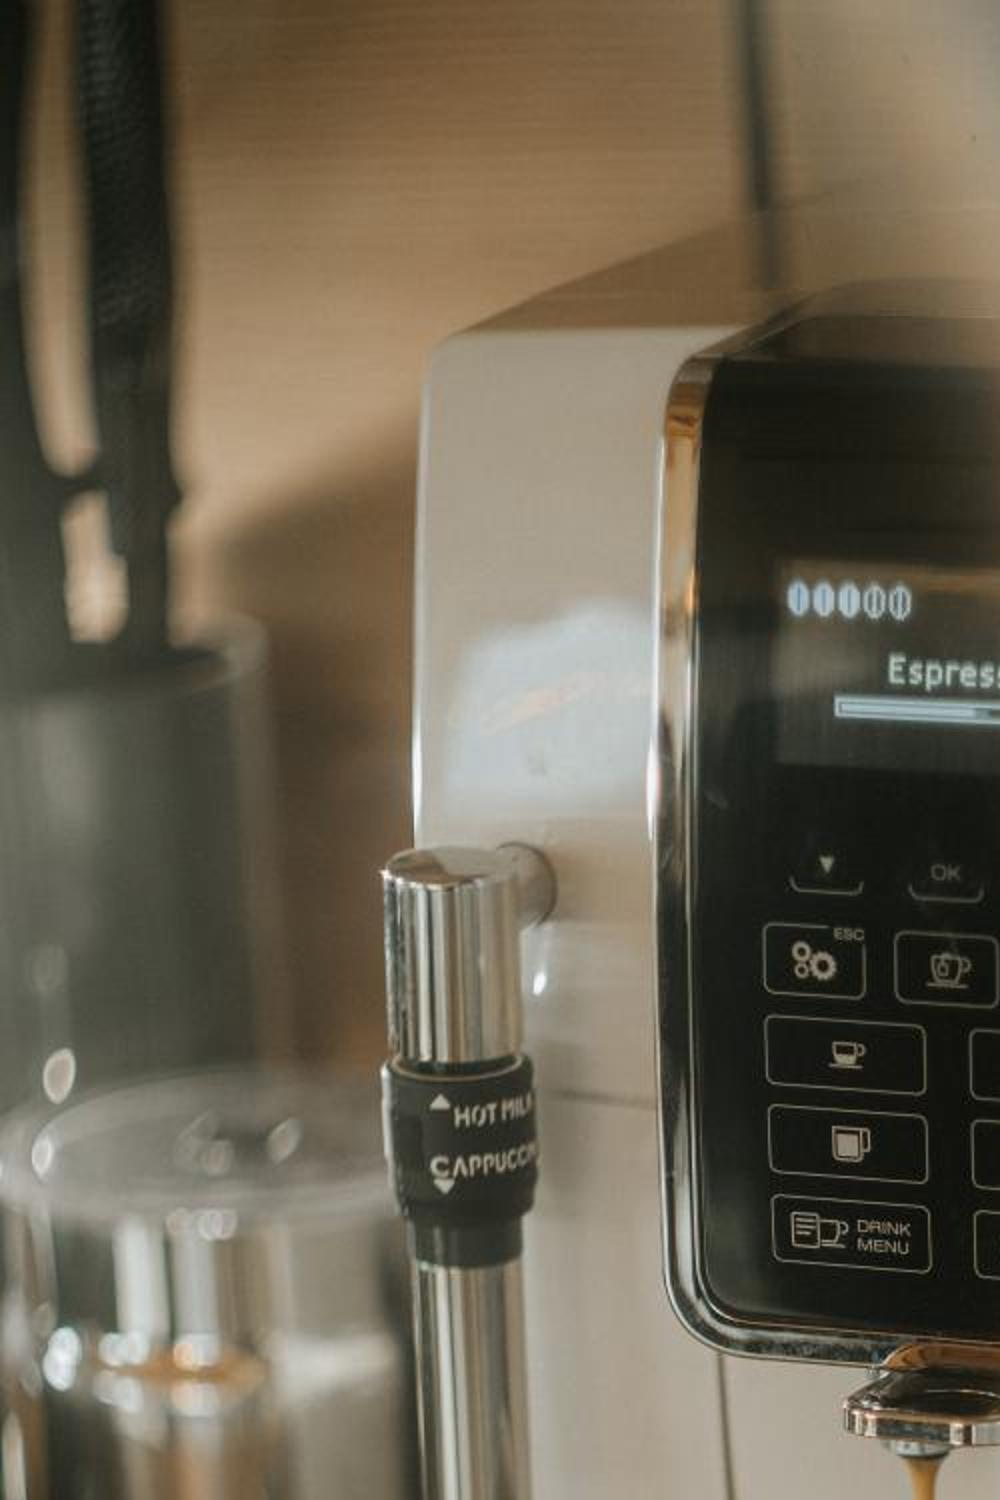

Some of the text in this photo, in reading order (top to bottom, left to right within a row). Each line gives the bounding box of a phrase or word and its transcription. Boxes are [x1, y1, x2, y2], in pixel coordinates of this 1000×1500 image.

[930, 863, 962, 882] OK
[833, 926, 866, 942] ESC
[453, 1103, 497, 1129] HOT
[856, 1218, 912, 1238] DRINK
[856, 1237, 910, 1256] MENU
